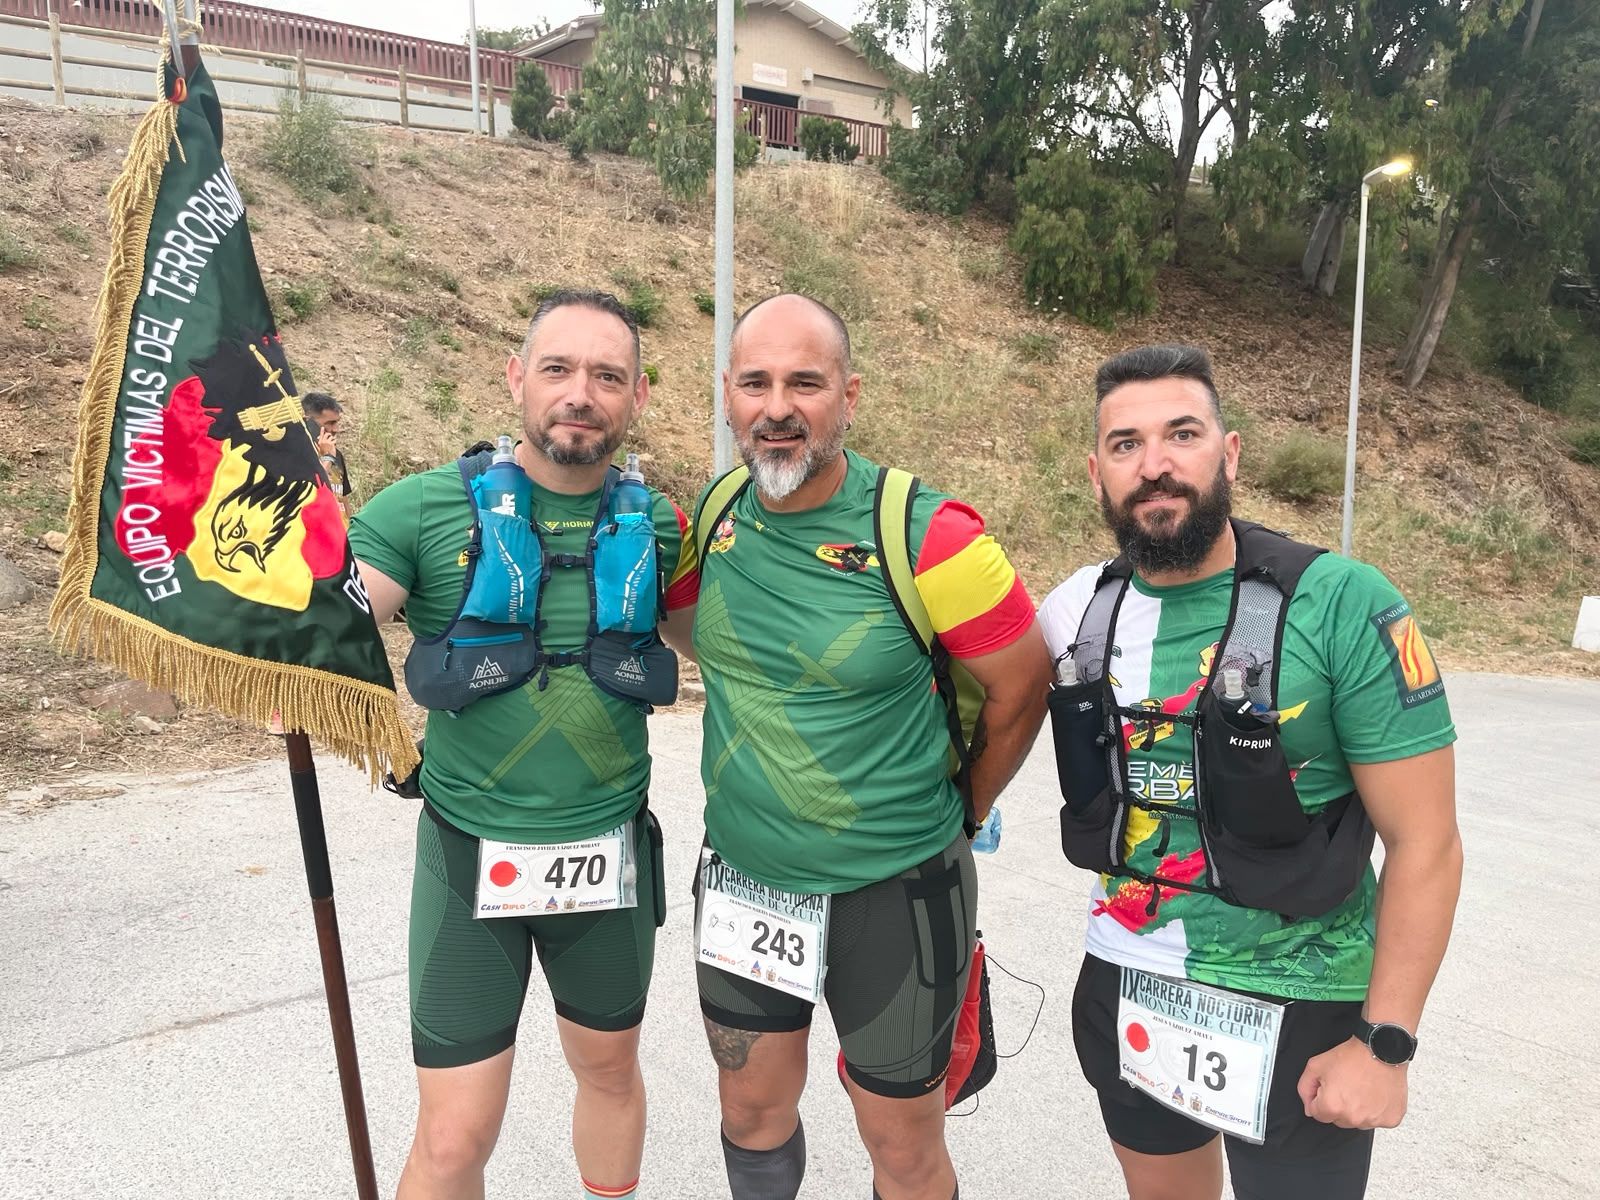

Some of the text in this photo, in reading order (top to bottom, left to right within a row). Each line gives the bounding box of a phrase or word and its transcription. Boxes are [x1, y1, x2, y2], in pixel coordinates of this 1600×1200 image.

[134, 314, 184, 363] DEL
[121, 369, 168, 490] VICTIMAS
[122, 504, 182, 602] EQUIPO
[468, 675, 510, 690] AONIJIE
[614, 670, 647, 682] AONIJIE
[1229, 736, 1272, 749] KIPRUN
[544, 854, 607, 889] 470
[707, 863, 725, 893] IX
[724, 866, 766, 896] CARRERA
[480, 903, 526, 911] CASH DIPLO
[724, 882, 822, 924] MONTES DE CEUTA
[701, 948, 717, 960] CASH
[751, 920, 805, 967] 243
[1121, 967, 1273, 1032] IX CARRERA NOCTURNA
[1137, 992, 1270, 1044] MONTES DE CEUTA
[1183, 1043, 1229, 1092] 13
